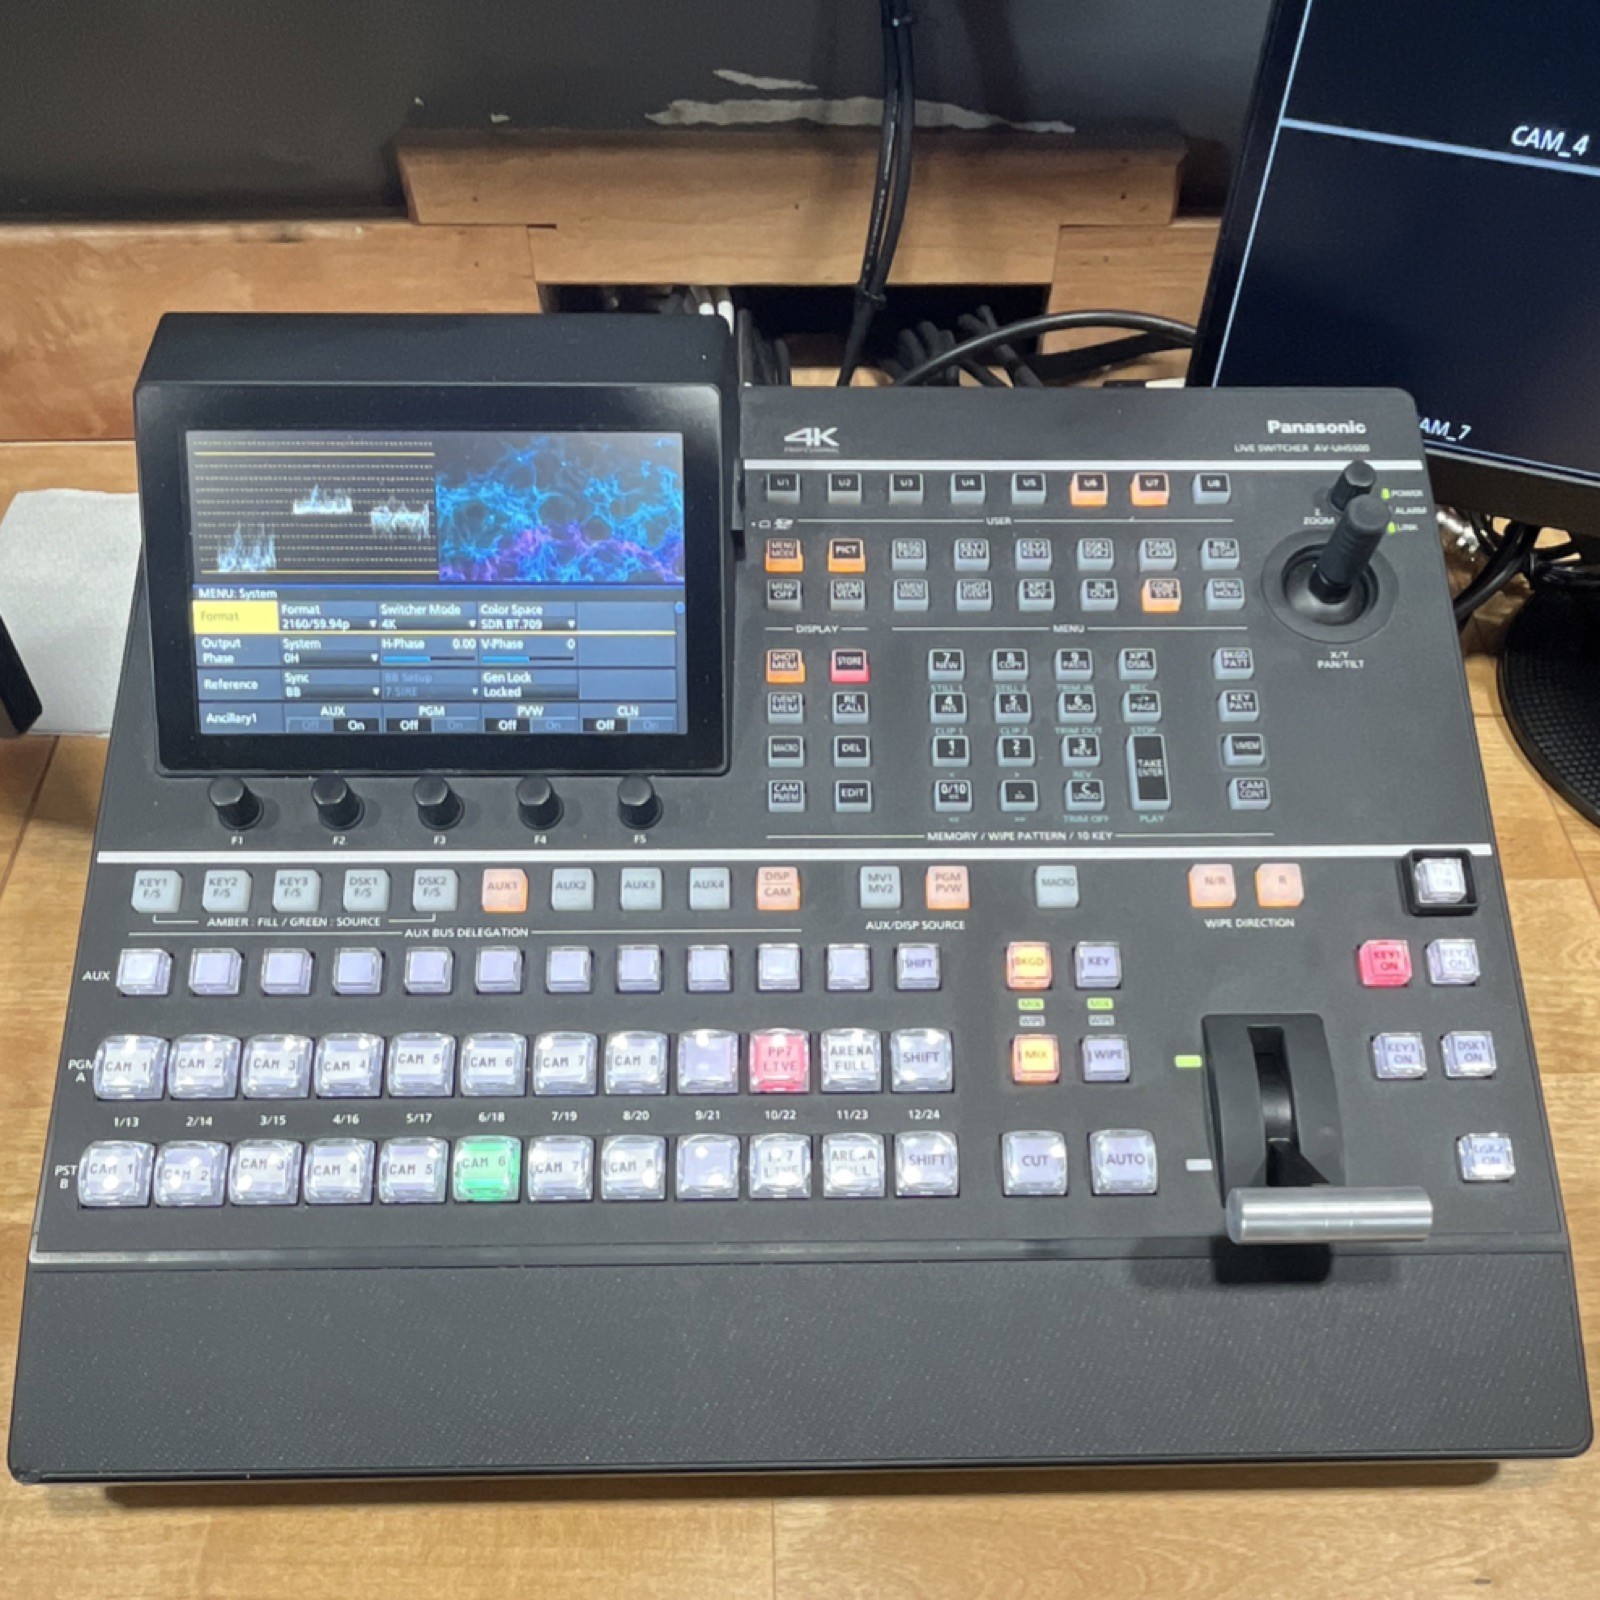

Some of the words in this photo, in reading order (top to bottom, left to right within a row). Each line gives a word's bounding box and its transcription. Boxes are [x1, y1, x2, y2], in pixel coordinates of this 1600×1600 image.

[1511, 126, 1590, 157] CAM_4
[1267, 420, 1367, 434] Panasonic
[1418, 417, 1471, 442] AM_7
[784, 427, 839, 446] 4K
[1234, 444, 1255, 452] LIVE
[1258, 444, 1309, 452] SWITCHER
[900, 479, 913, 487] U3
[1022, 479, 1037, 487] U5
[1084, 479, 1098, 487] U6
[1207, 479, 1221, 487] U8
[987, 516, 1012, 526] USER
[1304, 517, 1335, 525] ZOOM
[199, 589, 236, 598] MENU:
[239, 589, 277, 601] System
[282, 604, 320, 615] Format
[381, 604, 426, 615] Switcher
[431, 604, 461, 614] Mode
[480, 605, 509, 615] Color
[512, 605, 543, 617] Space
[201, 611, 239, 621] Format
[282, 619, 350, 631] 2160/59.94p
[382, 619, 397, 629] 4K
[481, 619, 503, 630] SDR
[506, 619, 542, 630] BT.709
[796, 625, 839, 633] DISPLAY
[1053, 625, 1085, 633] MENU
[202, 639, 241, 651] Output
[283, 639, 321, 651] System
[382, 639, 425, 649] H-Phase
[452, 639, 477, 649] 0.00
[481, 639, 523, 649] V-Phase
[567, 639, 575, 649] 0
[203, 653, 234, 663] Phase
[1317, 660, 1364, 669] PAN/TILT
[285, 673, 309, 684] Sync
[483, 673, 505, 683] Gen
[507, 672, 531, 683] Lock
[204, 679, 258, 690] Reference
[285, 687, 301, 697] BB
[484, 687, 522, 698] Locked
[320, 706, 345, 716] AUX
[418, 706, 445, 716] PGM
[517, 706, 544, 716] PVW
[616, 706, 638, 716] CLN
[206, 712, 257, 725] Ancillary1
[348, 721, 365, 731] On
[400, 721, 419, 731] Off
[499, 721, 517, 731] Off
[596, 721, 615, 731] Off
[841, 788, 865, 797] EDIT
[941, 783, 966, 794] 0/10
[232, 835, 243, 845] F1
[333, 836, 346, 845] F2
[434, 835, 446, 845] F3
[534, 834, 547, 844] F4
[634, 834, 647, 844] F5
[927, 832, 978, 841] MEMORY
[988, 832, 1014, 841] WIPE
[1017, 832, 1066, 841] PATTERN
[1077, 832, 1089, 841] 10
[1092, 832, 1113, 841] KEY
[764, 871, 790, 881] DISP
[868, 873, 892, 882] MV1
[935, 873, 961, 881] PGM
[139, 878, 168, 887] KEY1
[209, 877, 238, 886] KEY2
[279, 877, 308, 886] KEY3
[350, 877, 377, 886] DSK1
[418, 877, 447, 886] DSK2
[487, 881, 518, 890] AUX1
[556, 880, 587, 890] AUX2
[624, 879, 656, 889] AUX3
[693, 879, 724, 889] AUX4
[214, 889, 230, 897] F/S
[284, 888, 301, 897] F/S
[354, 887, 371, 897] F/S
[423, 887, 441, 896] F/S
[764, 887, 791, 897] CAM
[868, 884, 894, 893] MV2
[936, 883, 962, 893] PVW
[143, 889, 160, 898] F/S
[207, 917, 249, 927] AMBER
[257, 917, 278, 927] FILL
[290, 917, 327, 927] GREEN
[337, 917, 380, 926] SOURCE
[866, 921, 919, 930] AUX/DISP
[922, 921, 965, 930] SOURCE
[1205, 918, 1233, 928] WIPE
[1236, 918, 1295, 928] DIRECTION
[405, 928, 430, 937] AUX
[432, 928, 454, 937] BUS
[457, 928, 529, 937] DELEGATION
[906, 959, 933, 969] SHIFT
[1088, 957, 1110, 966] KEY
[82, 971, 110, 981] AUX
[831, 1046, 873, 1056] ARENA
[1095, 1050, 1123, 1059] WIPE
[398, 1054, 425, 1064] CAM
[470, 1057, 496, 1067] CAM
[903, 1052, 940, 1064] SHIFT
[1464, 1053, 1482, 1061] ON
[105, 1061, 131, 1073] CAM
[178, 1058, 205, 1069] CAM
[253, 1059, 280, 1070] CAM
[324, 1061, 350, 1072] CAM
[543, 1057, 569, 1068] CAM
[763, 1061, 797, 1071] LIVE
[835, 1060, 869, 1071] FULL
[76, 1073, 86, 1082] A
[333, 1114, 360, 1124] 4/16
[406, 1113, 433, 1123] 5/17
[479, 1112, 505, 1122] 6/18
[552, 1111, 578, 1121] 7/19
[623, 1110, 649, 1121] 8/20
[695, 1110, 720, 1120] 9/21
[764, 1110, 797, 1120] 10/22
[837, 1110, 869, 1120] 11/23
[908, 1109, 940, 1120] 12/24
[114, 1117, 139, 1127] 1/13
[185, 1116, 213, 1127] 2/14
[260, 1115, 287, 1126] 3/15
[461, 1157, 488, 1168] CAM
[909, 1155, 947, 1166] SHIFT
[1022, 1155, 1047, 1166] CUT
[1106, 1154, 1145, 1165] AUTO
[390, 1164, 415, 1174] CAM
[535, 1163, 563, 1173] CAM
[60, 1179, 68, 1188] B
